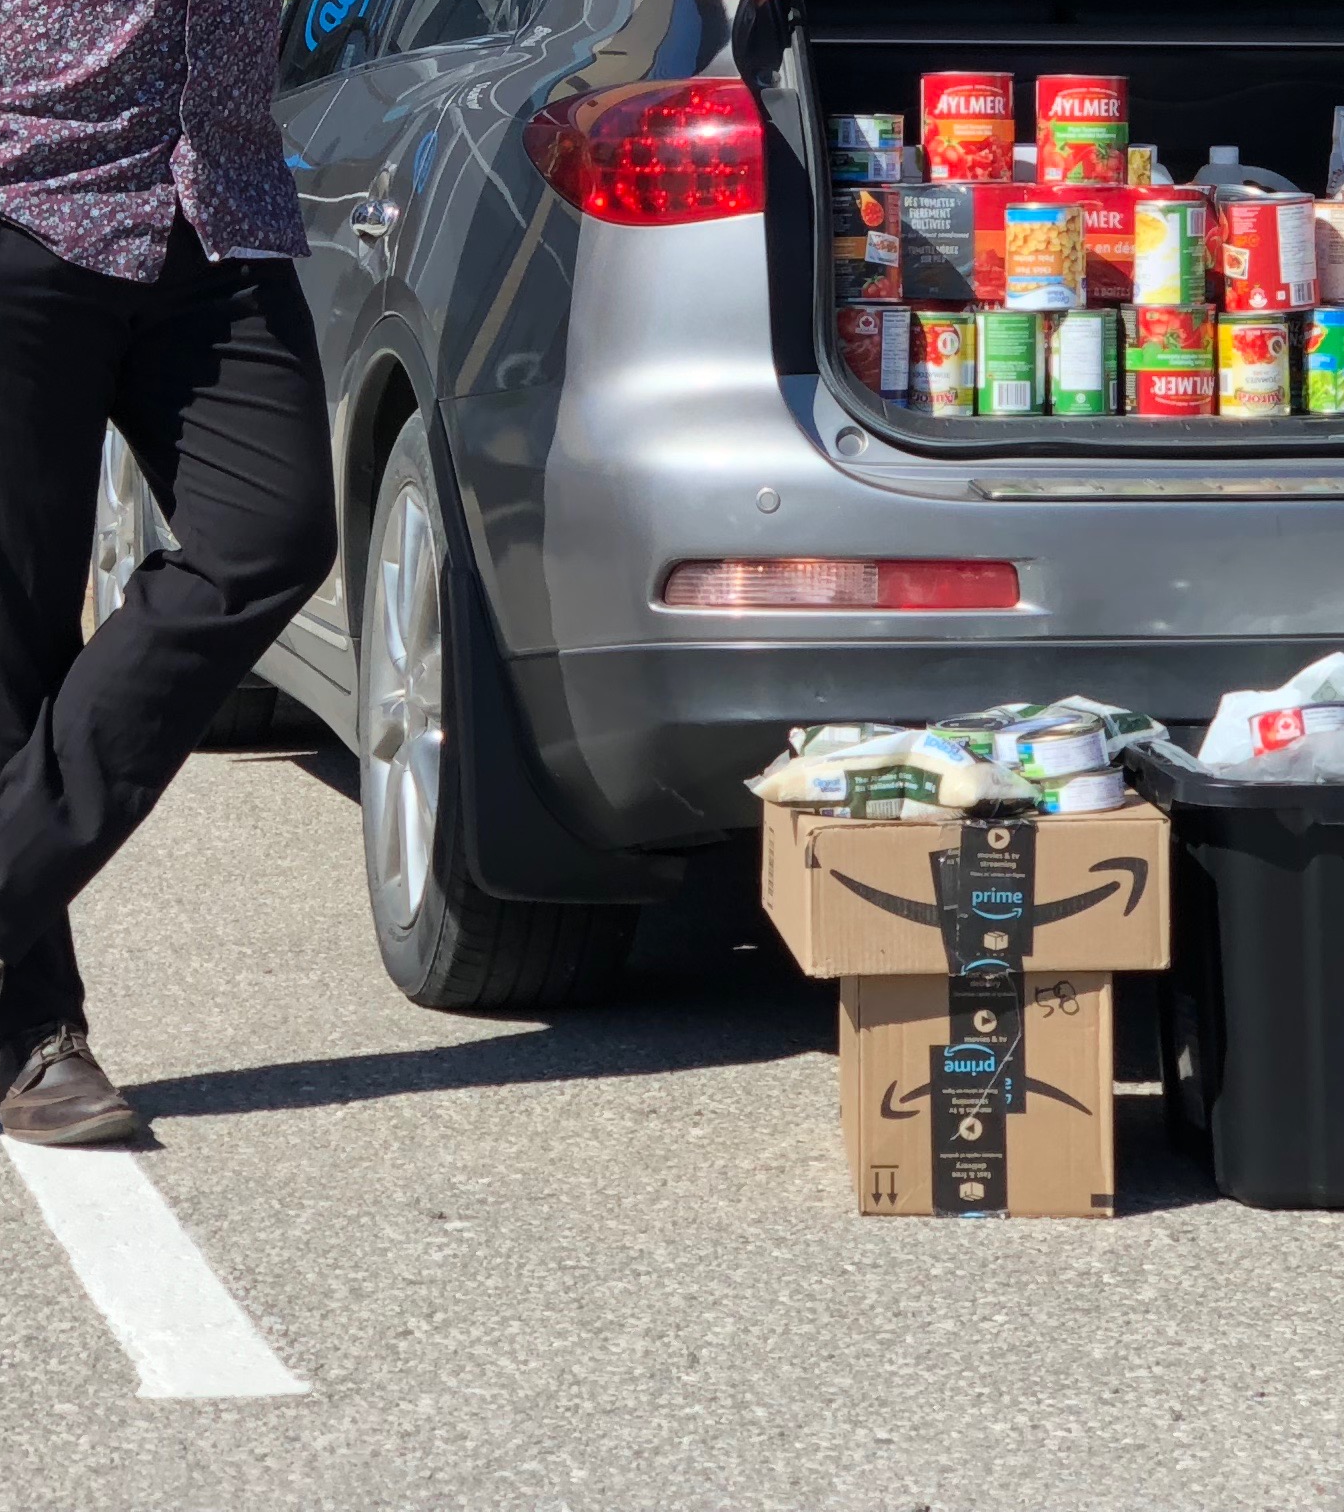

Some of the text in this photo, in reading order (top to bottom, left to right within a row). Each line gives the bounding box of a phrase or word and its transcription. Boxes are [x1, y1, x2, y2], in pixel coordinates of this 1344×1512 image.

[934, 94, 1006, 115] AYLMER
[1048, 96, 1120, 116] AYLMER
[1084, 210, 1123, 229] MER
[1151, 375, 1215, 396] AYLMER
[972, 888, 1023, 907] prime
[944, 1057, 995, 1077] prime
